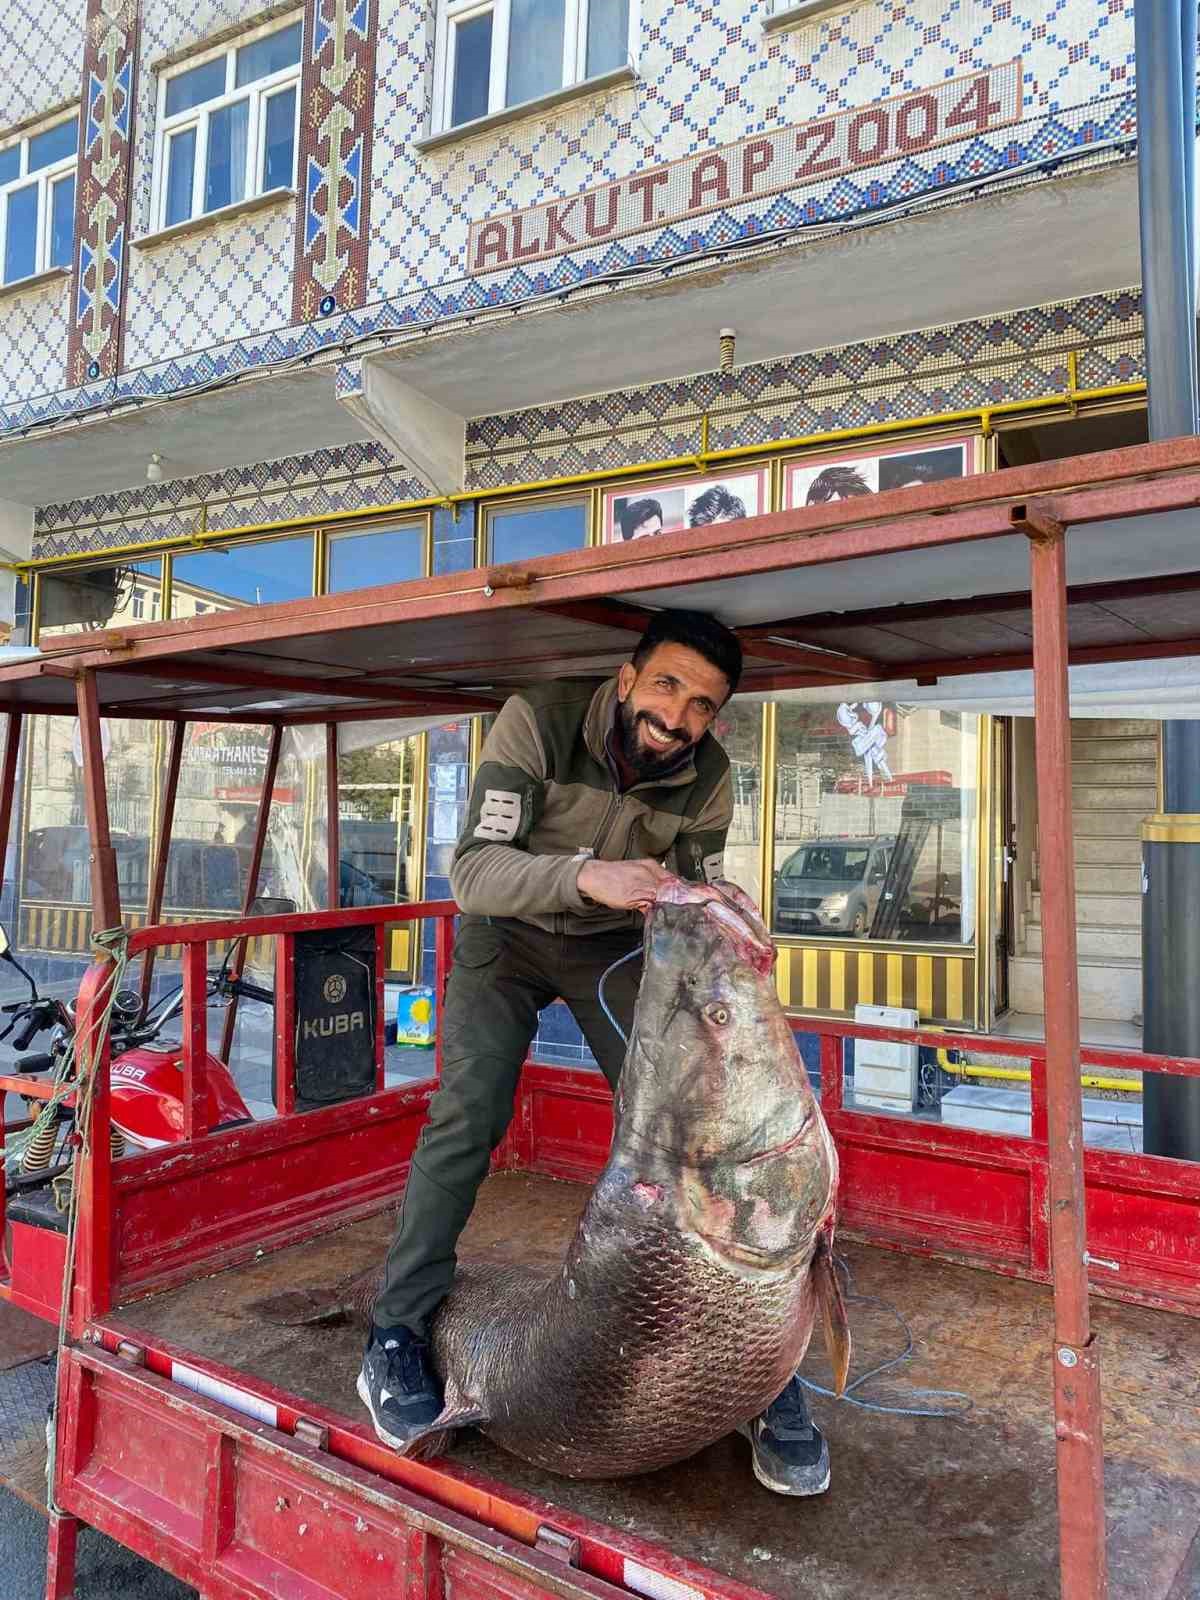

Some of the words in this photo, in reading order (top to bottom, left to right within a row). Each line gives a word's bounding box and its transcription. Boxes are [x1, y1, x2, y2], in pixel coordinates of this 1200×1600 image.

[689, 139, 775, 208] AP
[795, 75, 1001, 178] 2004
[303, 1011, 364, 1039] KUBA
[111, 1063, 147, 1081] UBA
